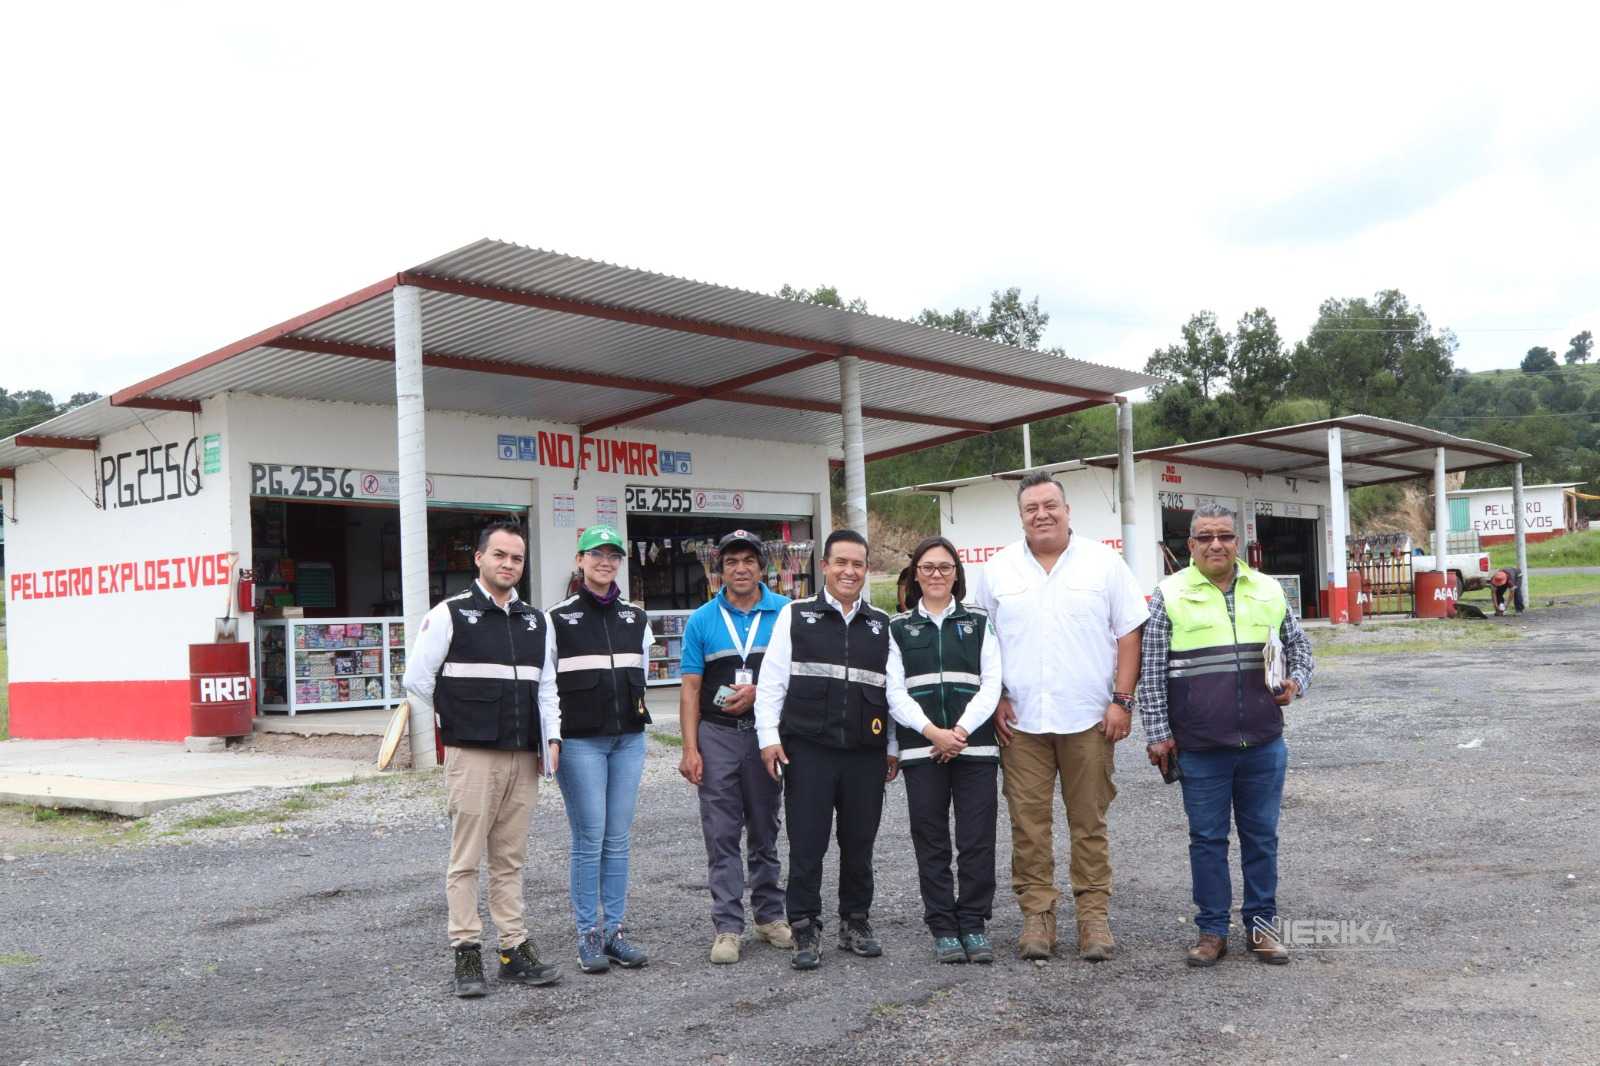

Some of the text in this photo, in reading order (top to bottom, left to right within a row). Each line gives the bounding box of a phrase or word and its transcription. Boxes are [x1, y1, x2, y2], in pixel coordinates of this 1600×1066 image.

[537, 431, 658, 476] NO FUMAR
[1474, 516, 1553, 531] EXPLOVOS
[1485, 502, 1541, 516] PELIRO
[11, 553, 230, 600] PELIGRO EXPLOSIVOS
